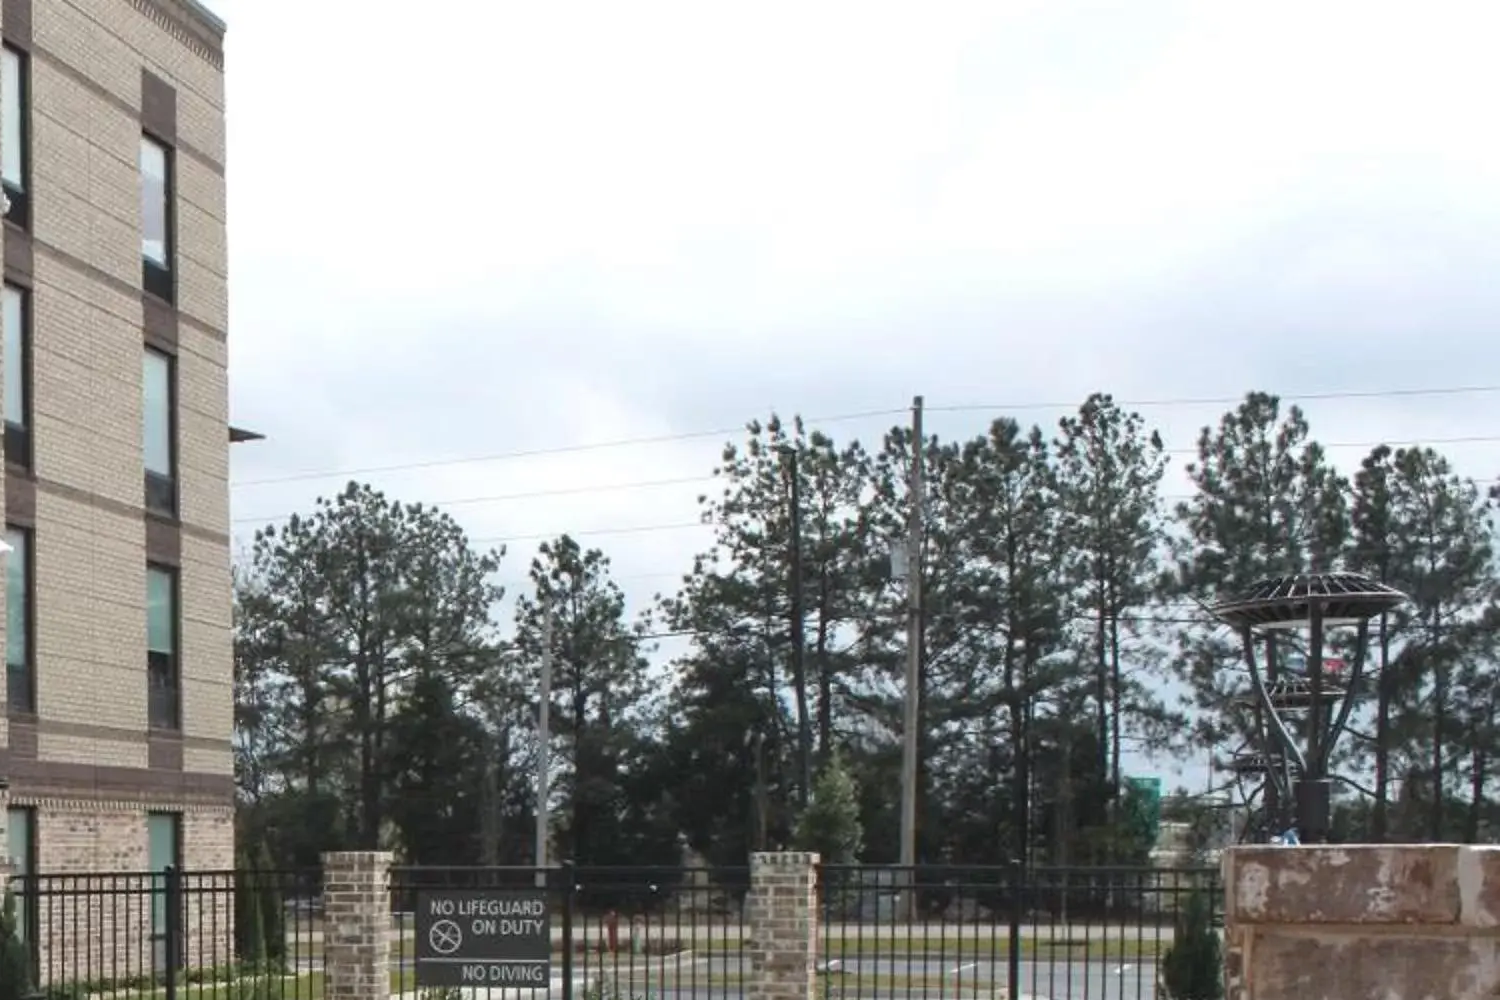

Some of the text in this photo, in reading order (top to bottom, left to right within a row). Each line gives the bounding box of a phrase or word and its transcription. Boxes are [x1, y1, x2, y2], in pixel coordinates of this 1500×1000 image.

[430, 901, 543, 915] NO LIFEGUARD
[471, 920, 543, 935] ON DUTY
[462, 965, 543, 980] NO DIVING
